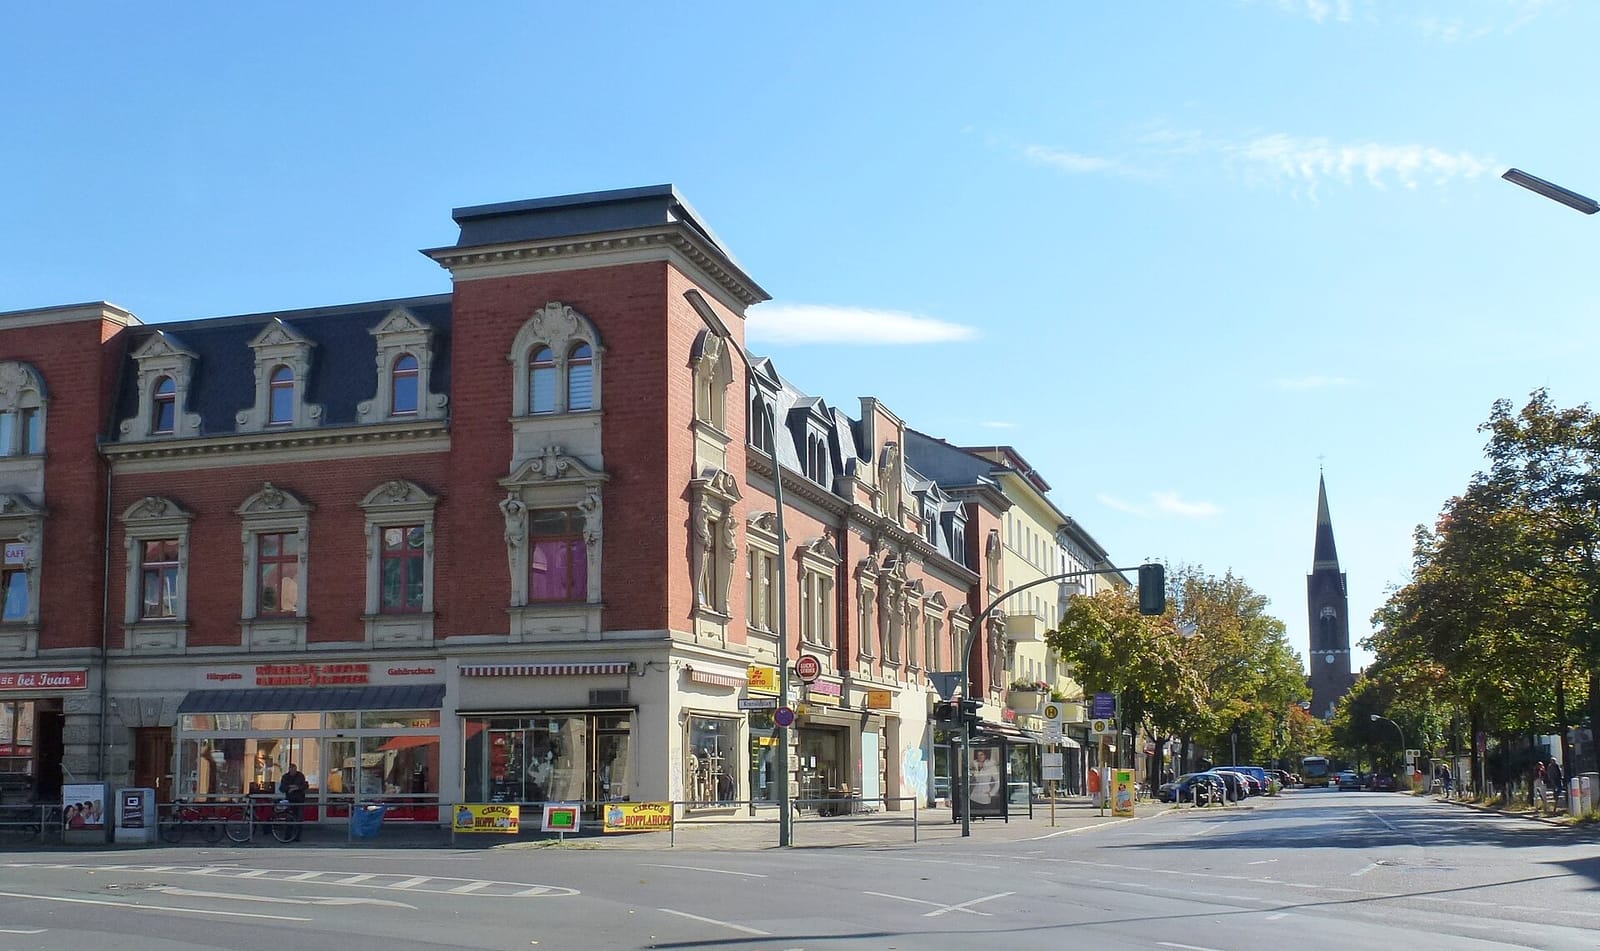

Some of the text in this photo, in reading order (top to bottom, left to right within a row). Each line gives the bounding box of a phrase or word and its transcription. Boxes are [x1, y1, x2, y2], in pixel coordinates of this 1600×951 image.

[17, 674, 35, 686] bei
[482, 806, 512, 815] CIRCUS
[633, 804, 665, 813] CIRCUS
[626, 815, 671, 826] HOPPLAHOPP
